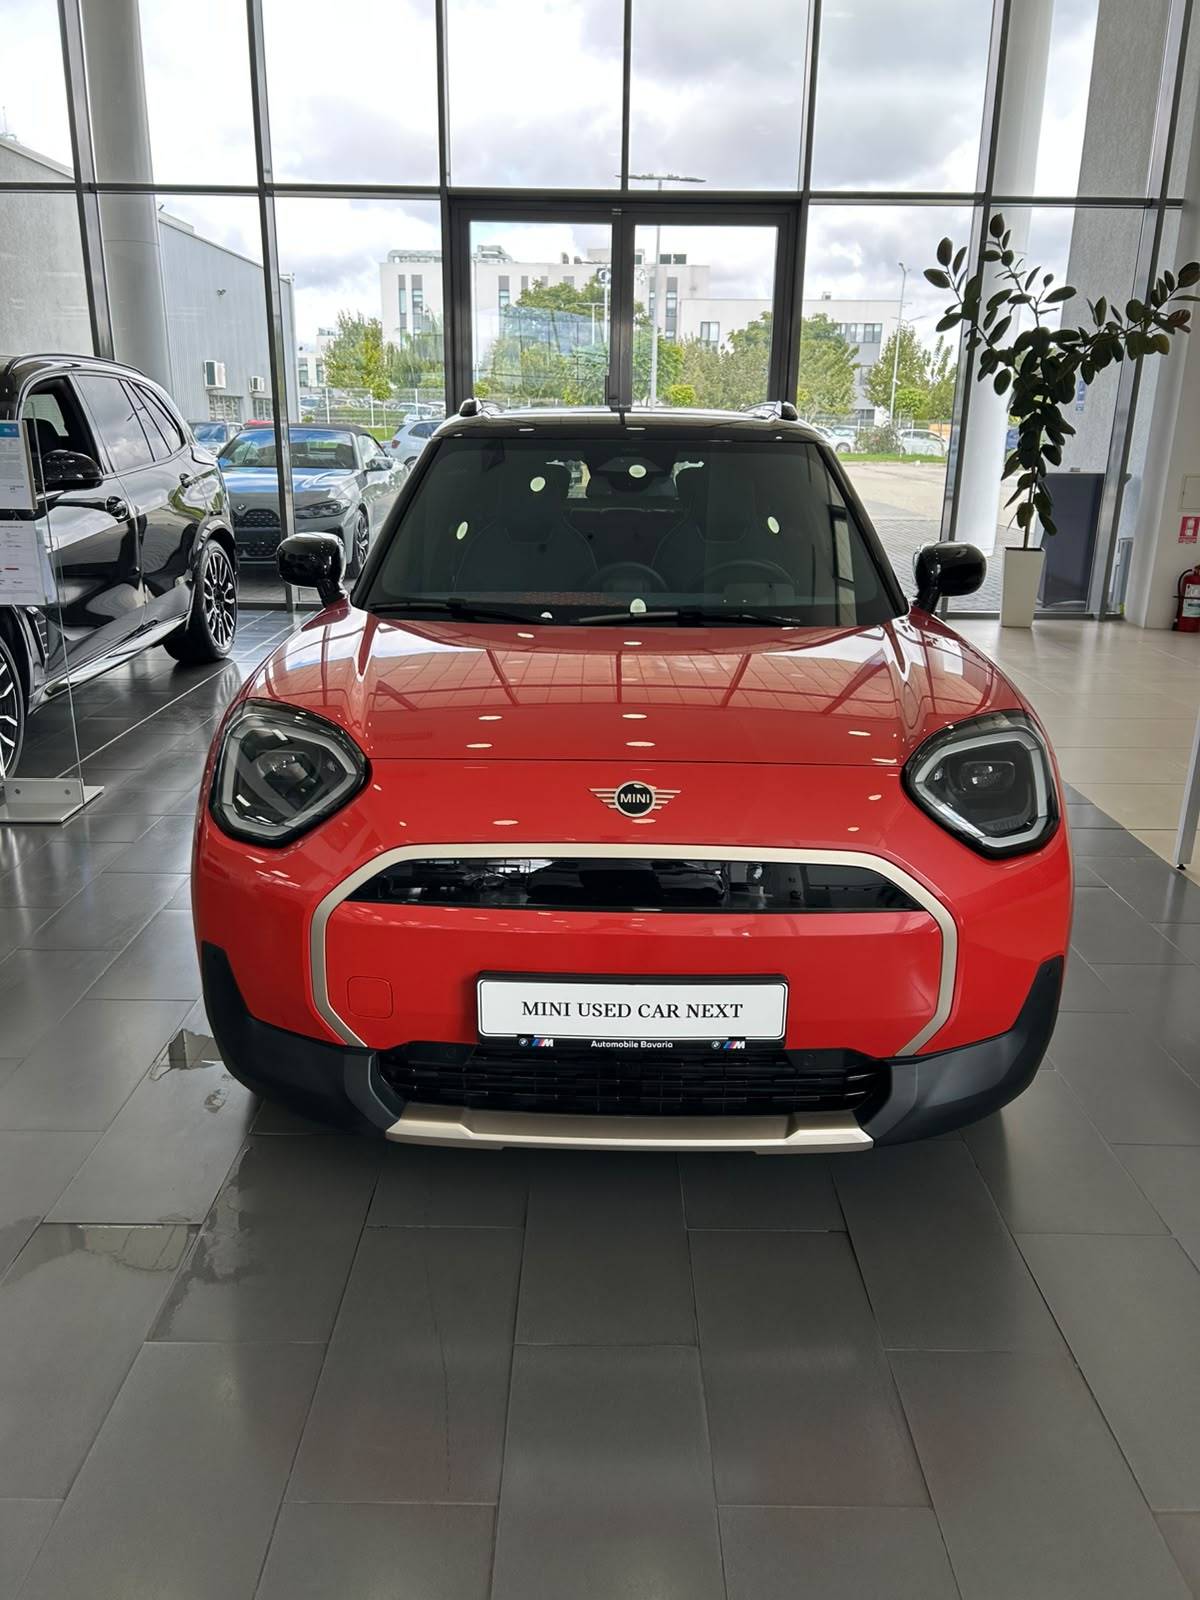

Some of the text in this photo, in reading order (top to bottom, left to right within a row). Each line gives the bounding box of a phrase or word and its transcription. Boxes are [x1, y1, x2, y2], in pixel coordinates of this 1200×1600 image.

[620, 793, 650, 804] MINI
[521, 1001, 744, 1019] MINI USED CAR NEXT
[590, 1040, 673, 1048] Automobile Bavaria
